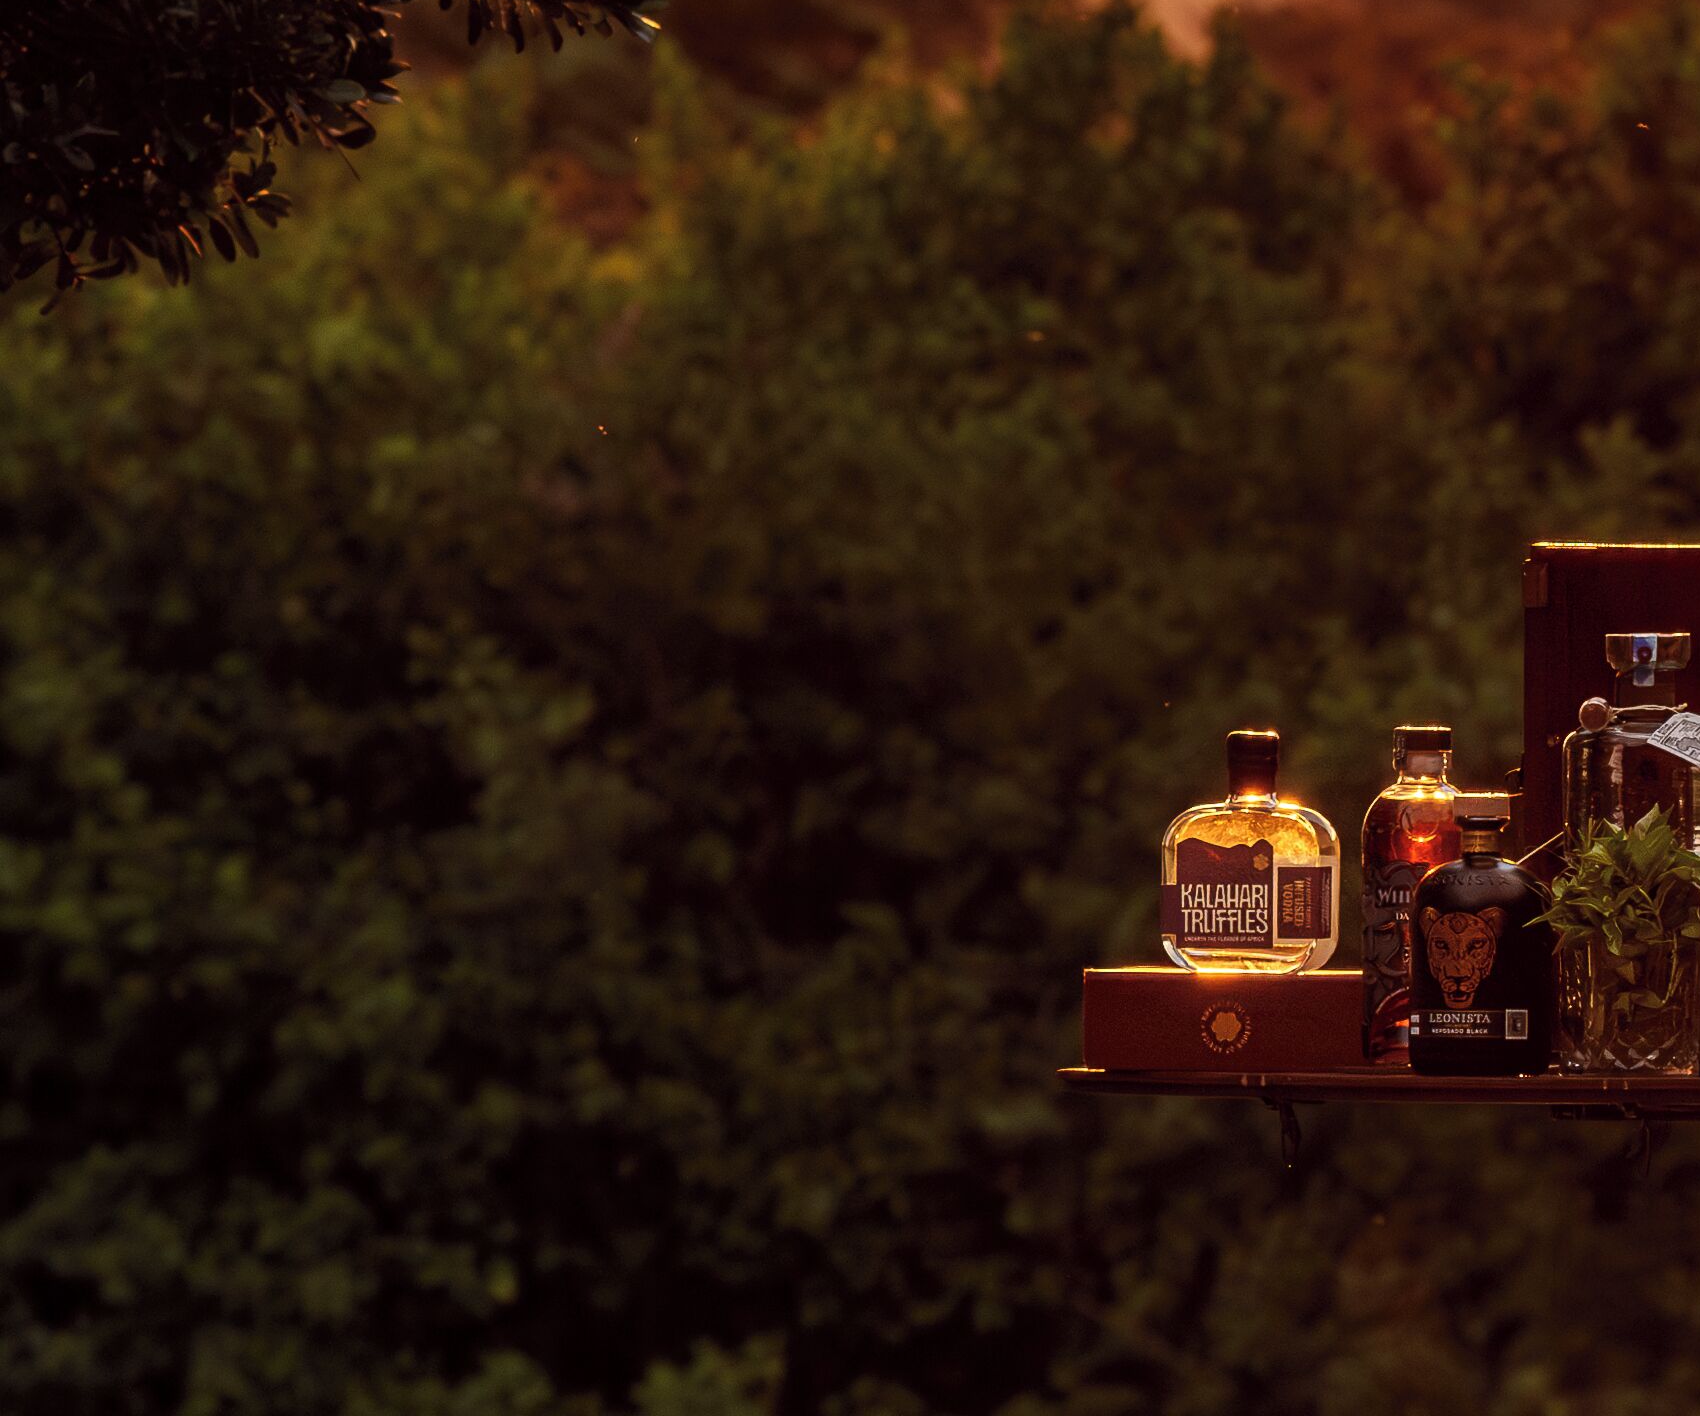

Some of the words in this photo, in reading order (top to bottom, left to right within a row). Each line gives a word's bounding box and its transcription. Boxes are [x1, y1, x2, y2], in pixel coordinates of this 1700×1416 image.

[1181, 883, 1268, 909] KALAHARI
[1282, 883, 1294, 924] VODKA
[1181, 909, 1268, 934] TRUFFLES
[1429, 1013, 1491, 1023] LEONISTA
